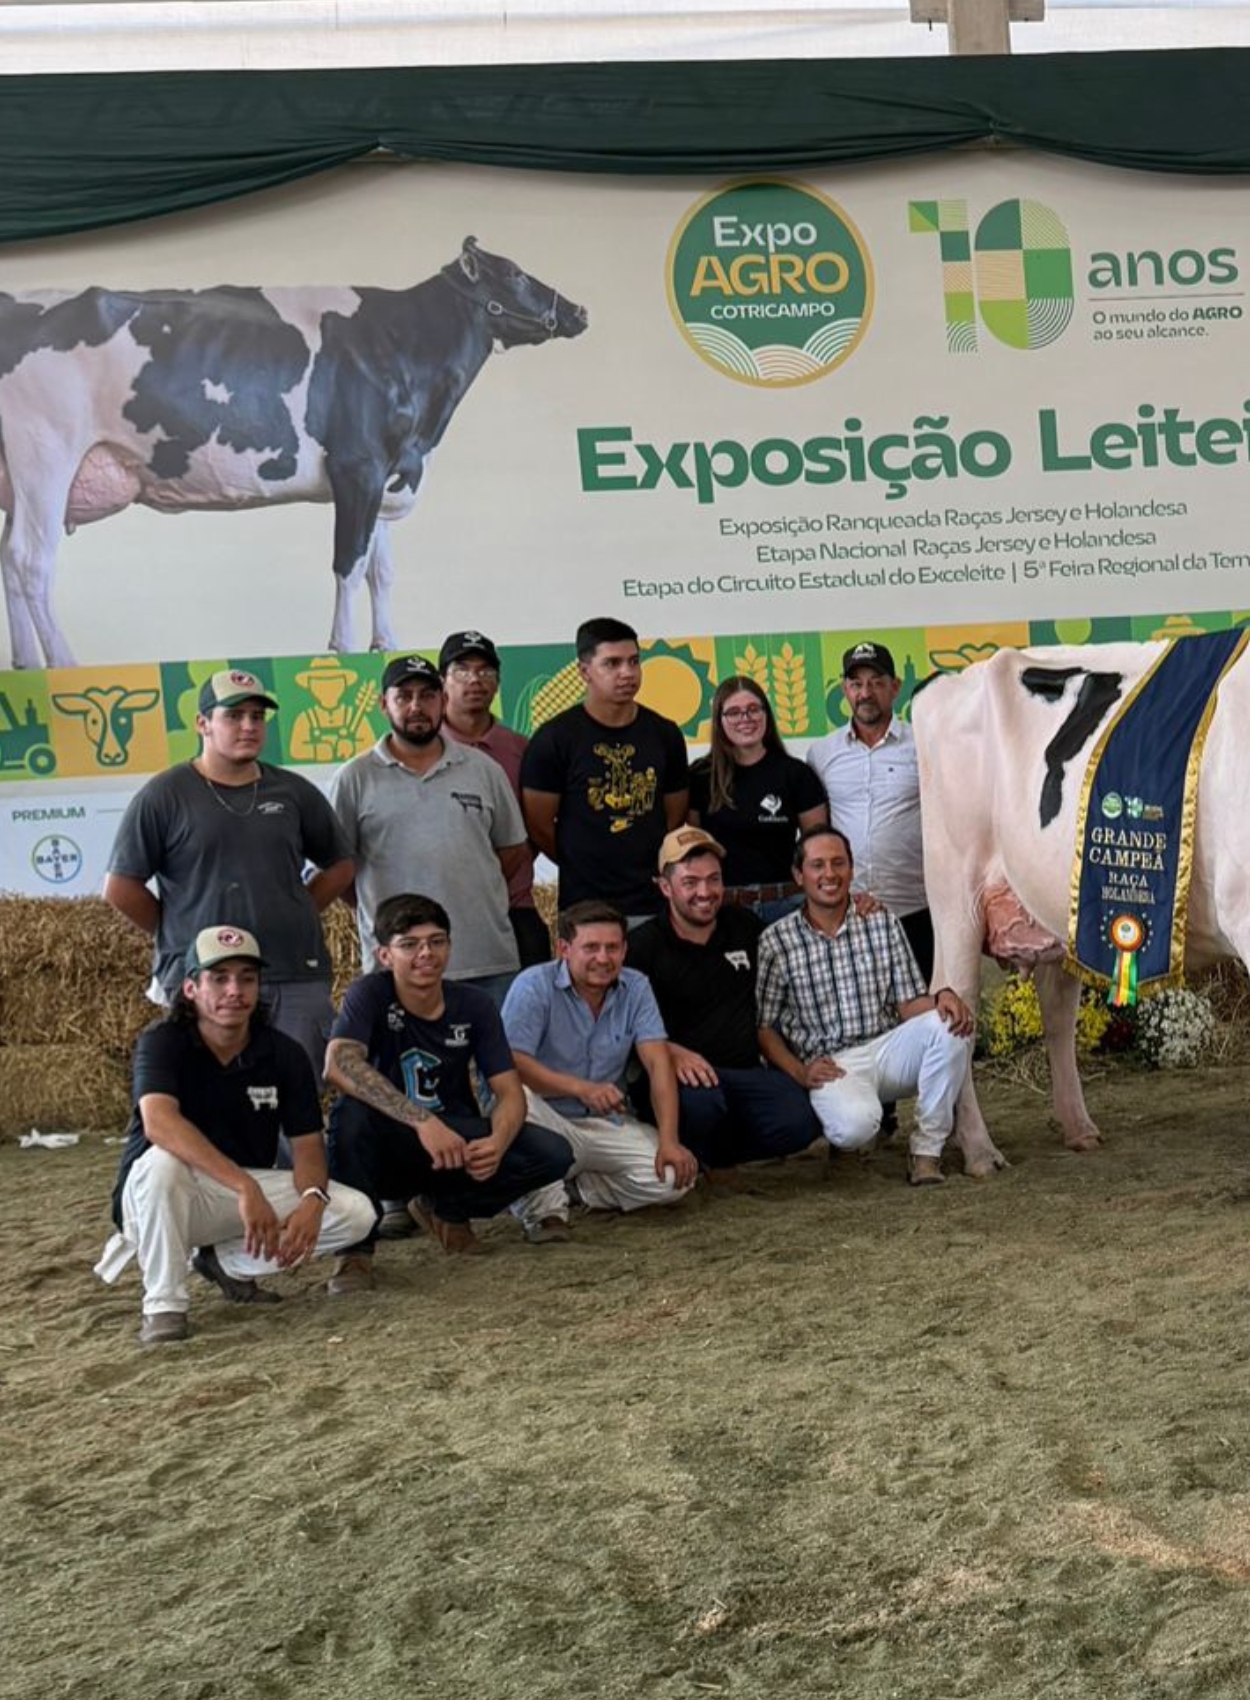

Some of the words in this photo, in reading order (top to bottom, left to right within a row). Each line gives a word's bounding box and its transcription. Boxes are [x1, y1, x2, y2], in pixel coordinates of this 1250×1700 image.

[713, 215, 818, 253] Expo
[689, 251, 850, 297] AGRO
[1087, 247, 1239, 289] anos
[710, 301, 836, 320] COTRICAMPO
[1092, 310, 1107, 324] O
[1109, 309, 1166, 325] mundo
[1168, 308, 1189, 322] do
[1192, 305, 1243, 321] AGRO
[1093, 328, 1114, 341] ao
[1115, 327, 1144, 340] seu
[1146, 324, 1210, 339] alcance.
[576, 416, 1012, 504] Exposição
[719, 513, 824, 538] Exposição
[825, 508, 941, 534] Ranqueada
[944, 507, 1003, 531] Raças
[1005, 504, 1068, 526] Jersey
[1069, 507, 1082, 521] e
[1085, 498, 1188, 520] Holandesa
[756, 545, 818, 565] Etapa
[819, 539, 907, 560] Nacional
[912, 536, 972, 559] Raças
[974, 534, 1036, 554] Jersey
[1038, 537, 1051, 551] e
[1053, 528, 1157, 550] Holandesa
[622, 579, 685, 600] Etapa
[687, 576, 716, 595] do
[717, 570, 797, 593] Circuito
[799, 567, 886, 590] Estadual
[888, 567, 917, 585] do
[918, 563, 1006, 584] Exceleite
[1048, 558, 1095, 578] Feira
[1098, 554, 1180, 577] Regional
[1182, 552, 1208, 571] da
[12, 806, 86, 821] PREMIUM
[1091, 826, 1167, 850] GRANDE
[36, 853, 77, 864] BAYER
[1108, 870, 1149, 890] RAÇA
